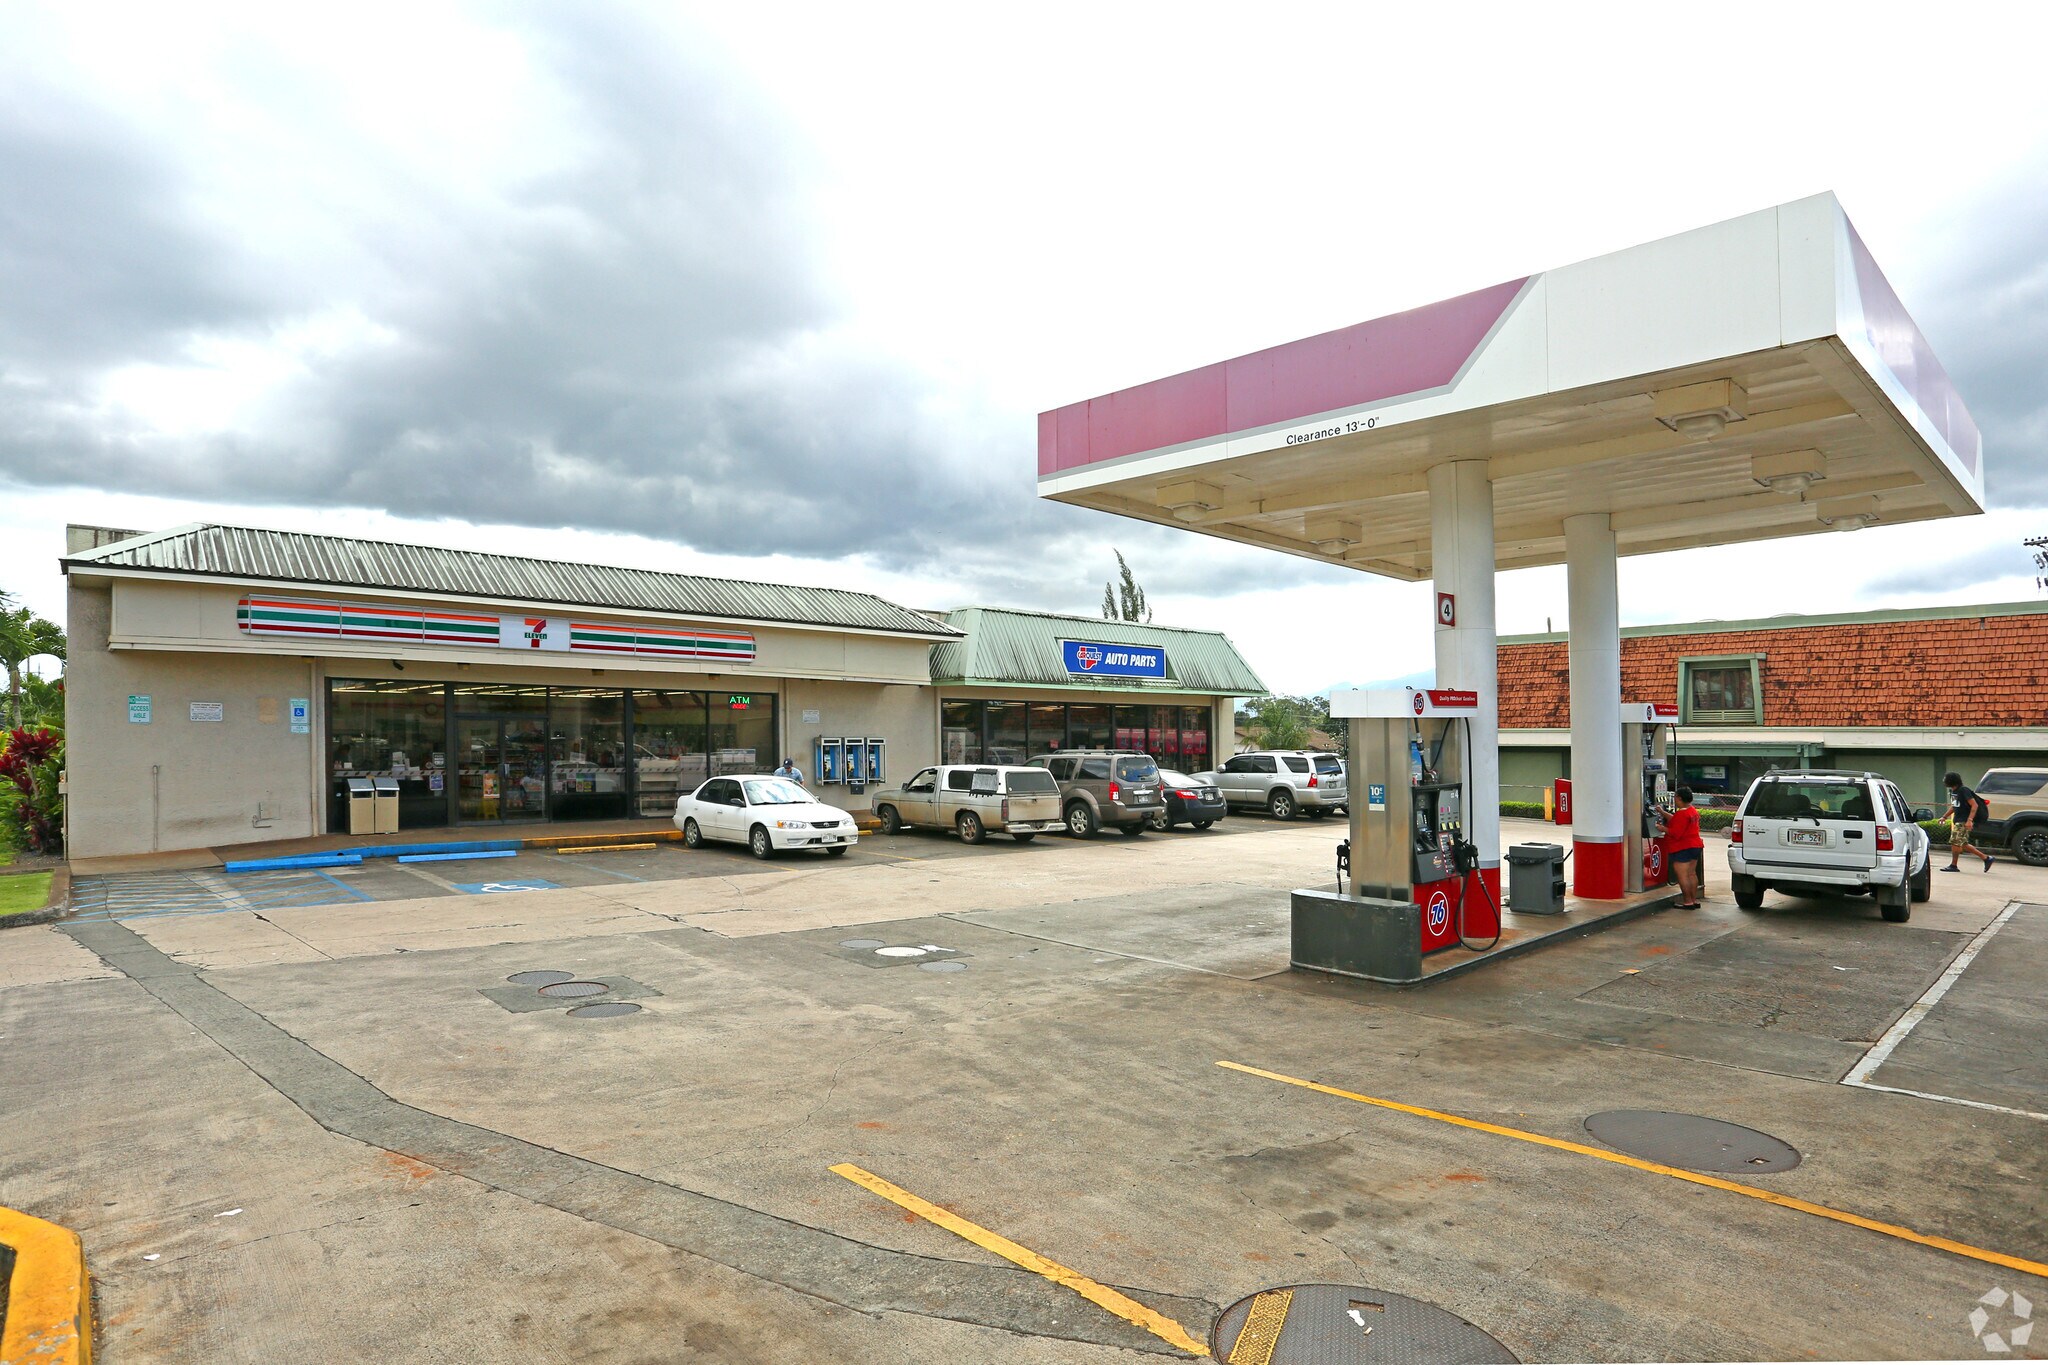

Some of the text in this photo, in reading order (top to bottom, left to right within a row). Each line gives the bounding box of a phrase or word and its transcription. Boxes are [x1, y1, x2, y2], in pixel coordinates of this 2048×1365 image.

[1286, 416, 1380, 445] Clearance 13'-0"
[1444, 604, 1451, 617] 4
[524, 618, 546, 648] 7
[1077, 652, 1102, 660] CARQUEST
[1105, 653, 1156, 667] AUTO PARTS
[729, 696, 750, 704] ATM
[1415, 697, 1424, 710] 76
[1431, 900, 1445, 925] 76
